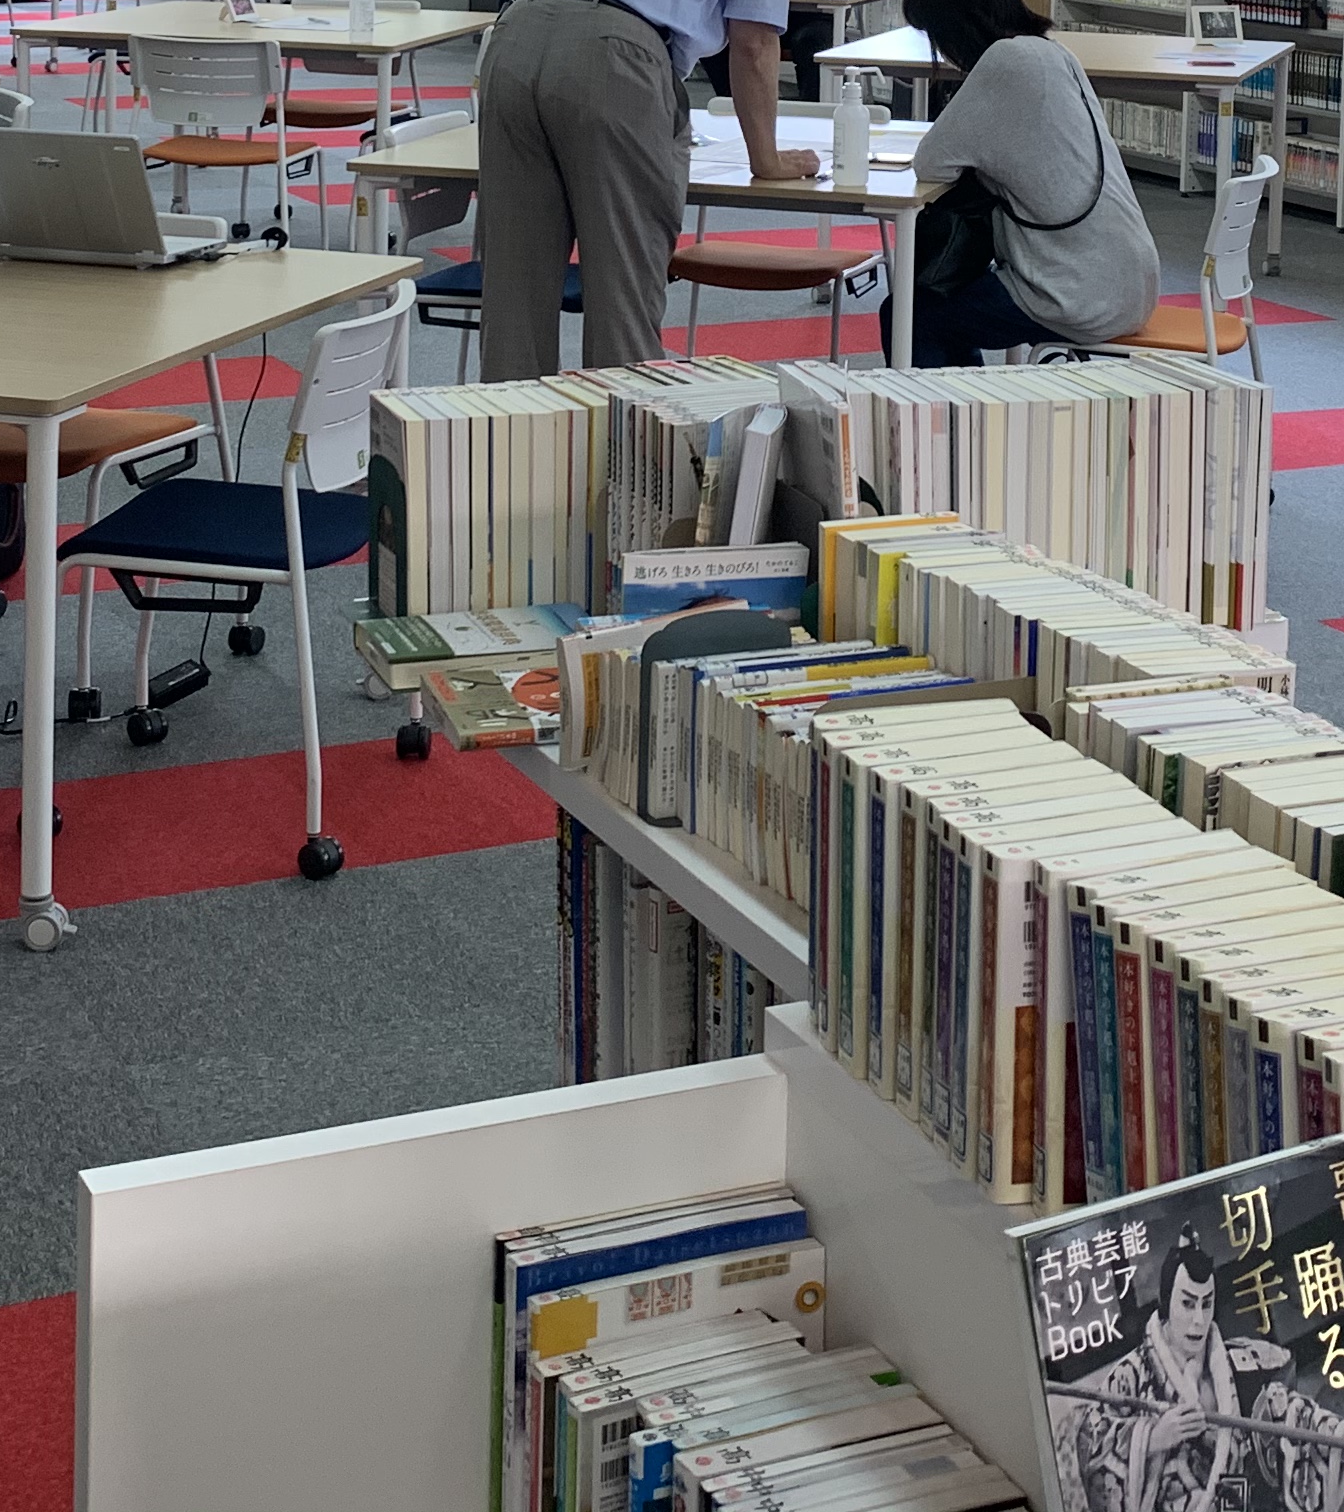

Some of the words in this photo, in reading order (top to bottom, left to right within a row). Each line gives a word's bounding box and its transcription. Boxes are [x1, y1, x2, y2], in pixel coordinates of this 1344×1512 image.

[1035, 1221, 1150, 1287] 古典芸能
[1219, 1186, 1289, 1335] 切手
[1041, 1264, 1138, 1324] トリビア
[1047, 1311, 1124, 1363] Book
